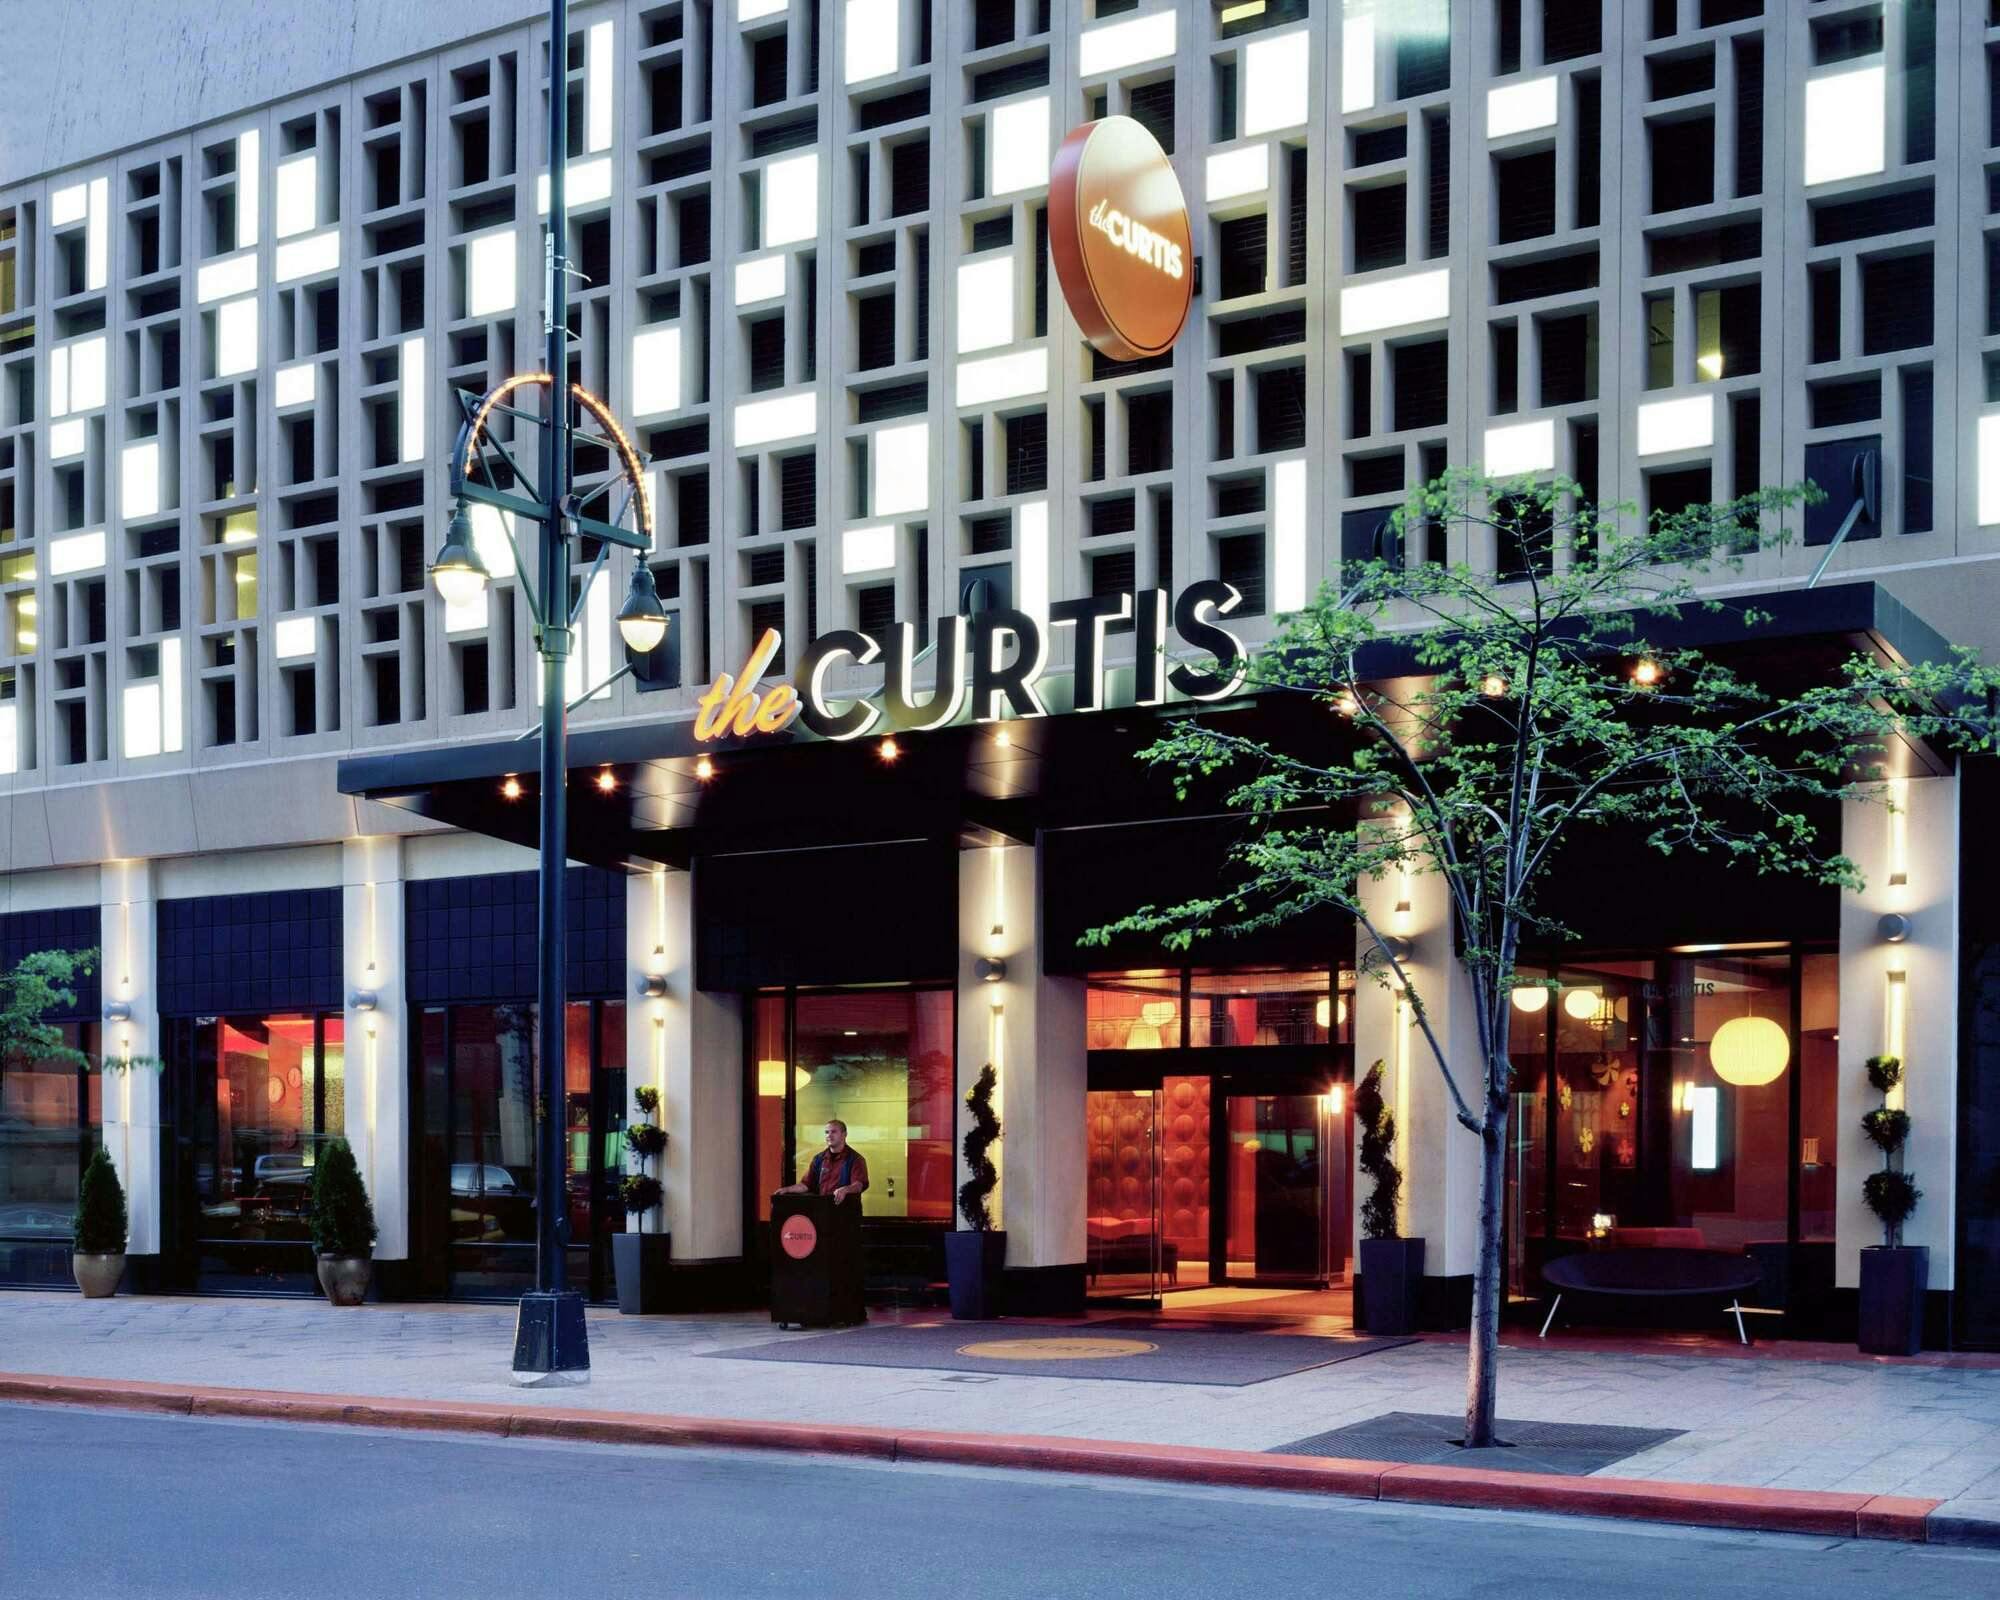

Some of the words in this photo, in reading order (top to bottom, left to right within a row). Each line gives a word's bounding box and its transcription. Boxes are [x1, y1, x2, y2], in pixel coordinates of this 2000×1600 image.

[1089, 198, 1111, 233] the
[1108, 210, 1183, 278] CURTIS
[694, 628, 803, 741] the
[798, 580, 1247, 740] CURTIS
